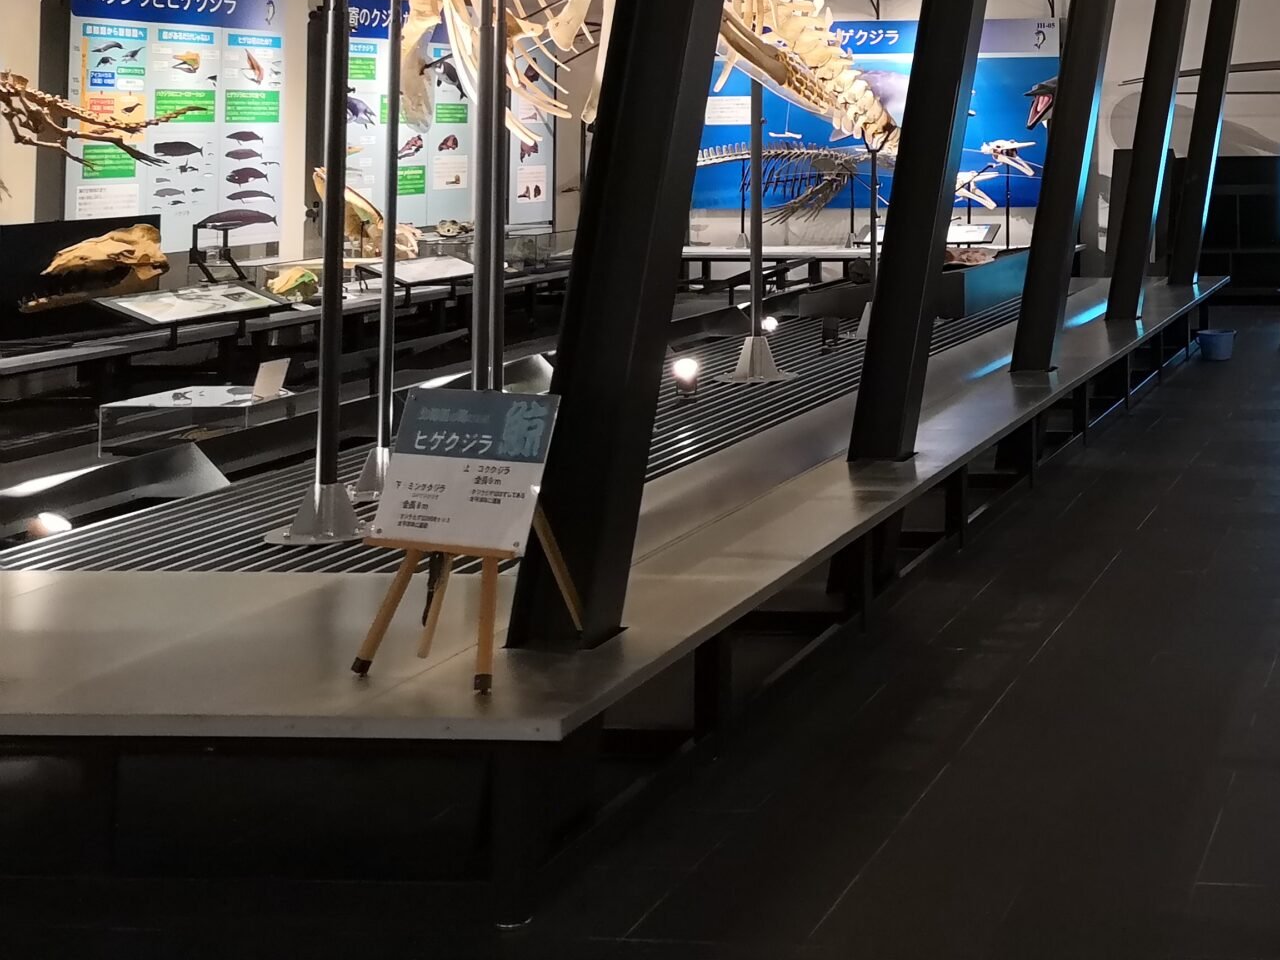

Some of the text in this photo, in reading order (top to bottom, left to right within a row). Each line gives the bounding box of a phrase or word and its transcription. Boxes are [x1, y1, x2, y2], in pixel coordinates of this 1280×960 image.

[831, 28, 900, 46] ゲクジラ
[414, 430, 493, 455] ヒゲクジラ
